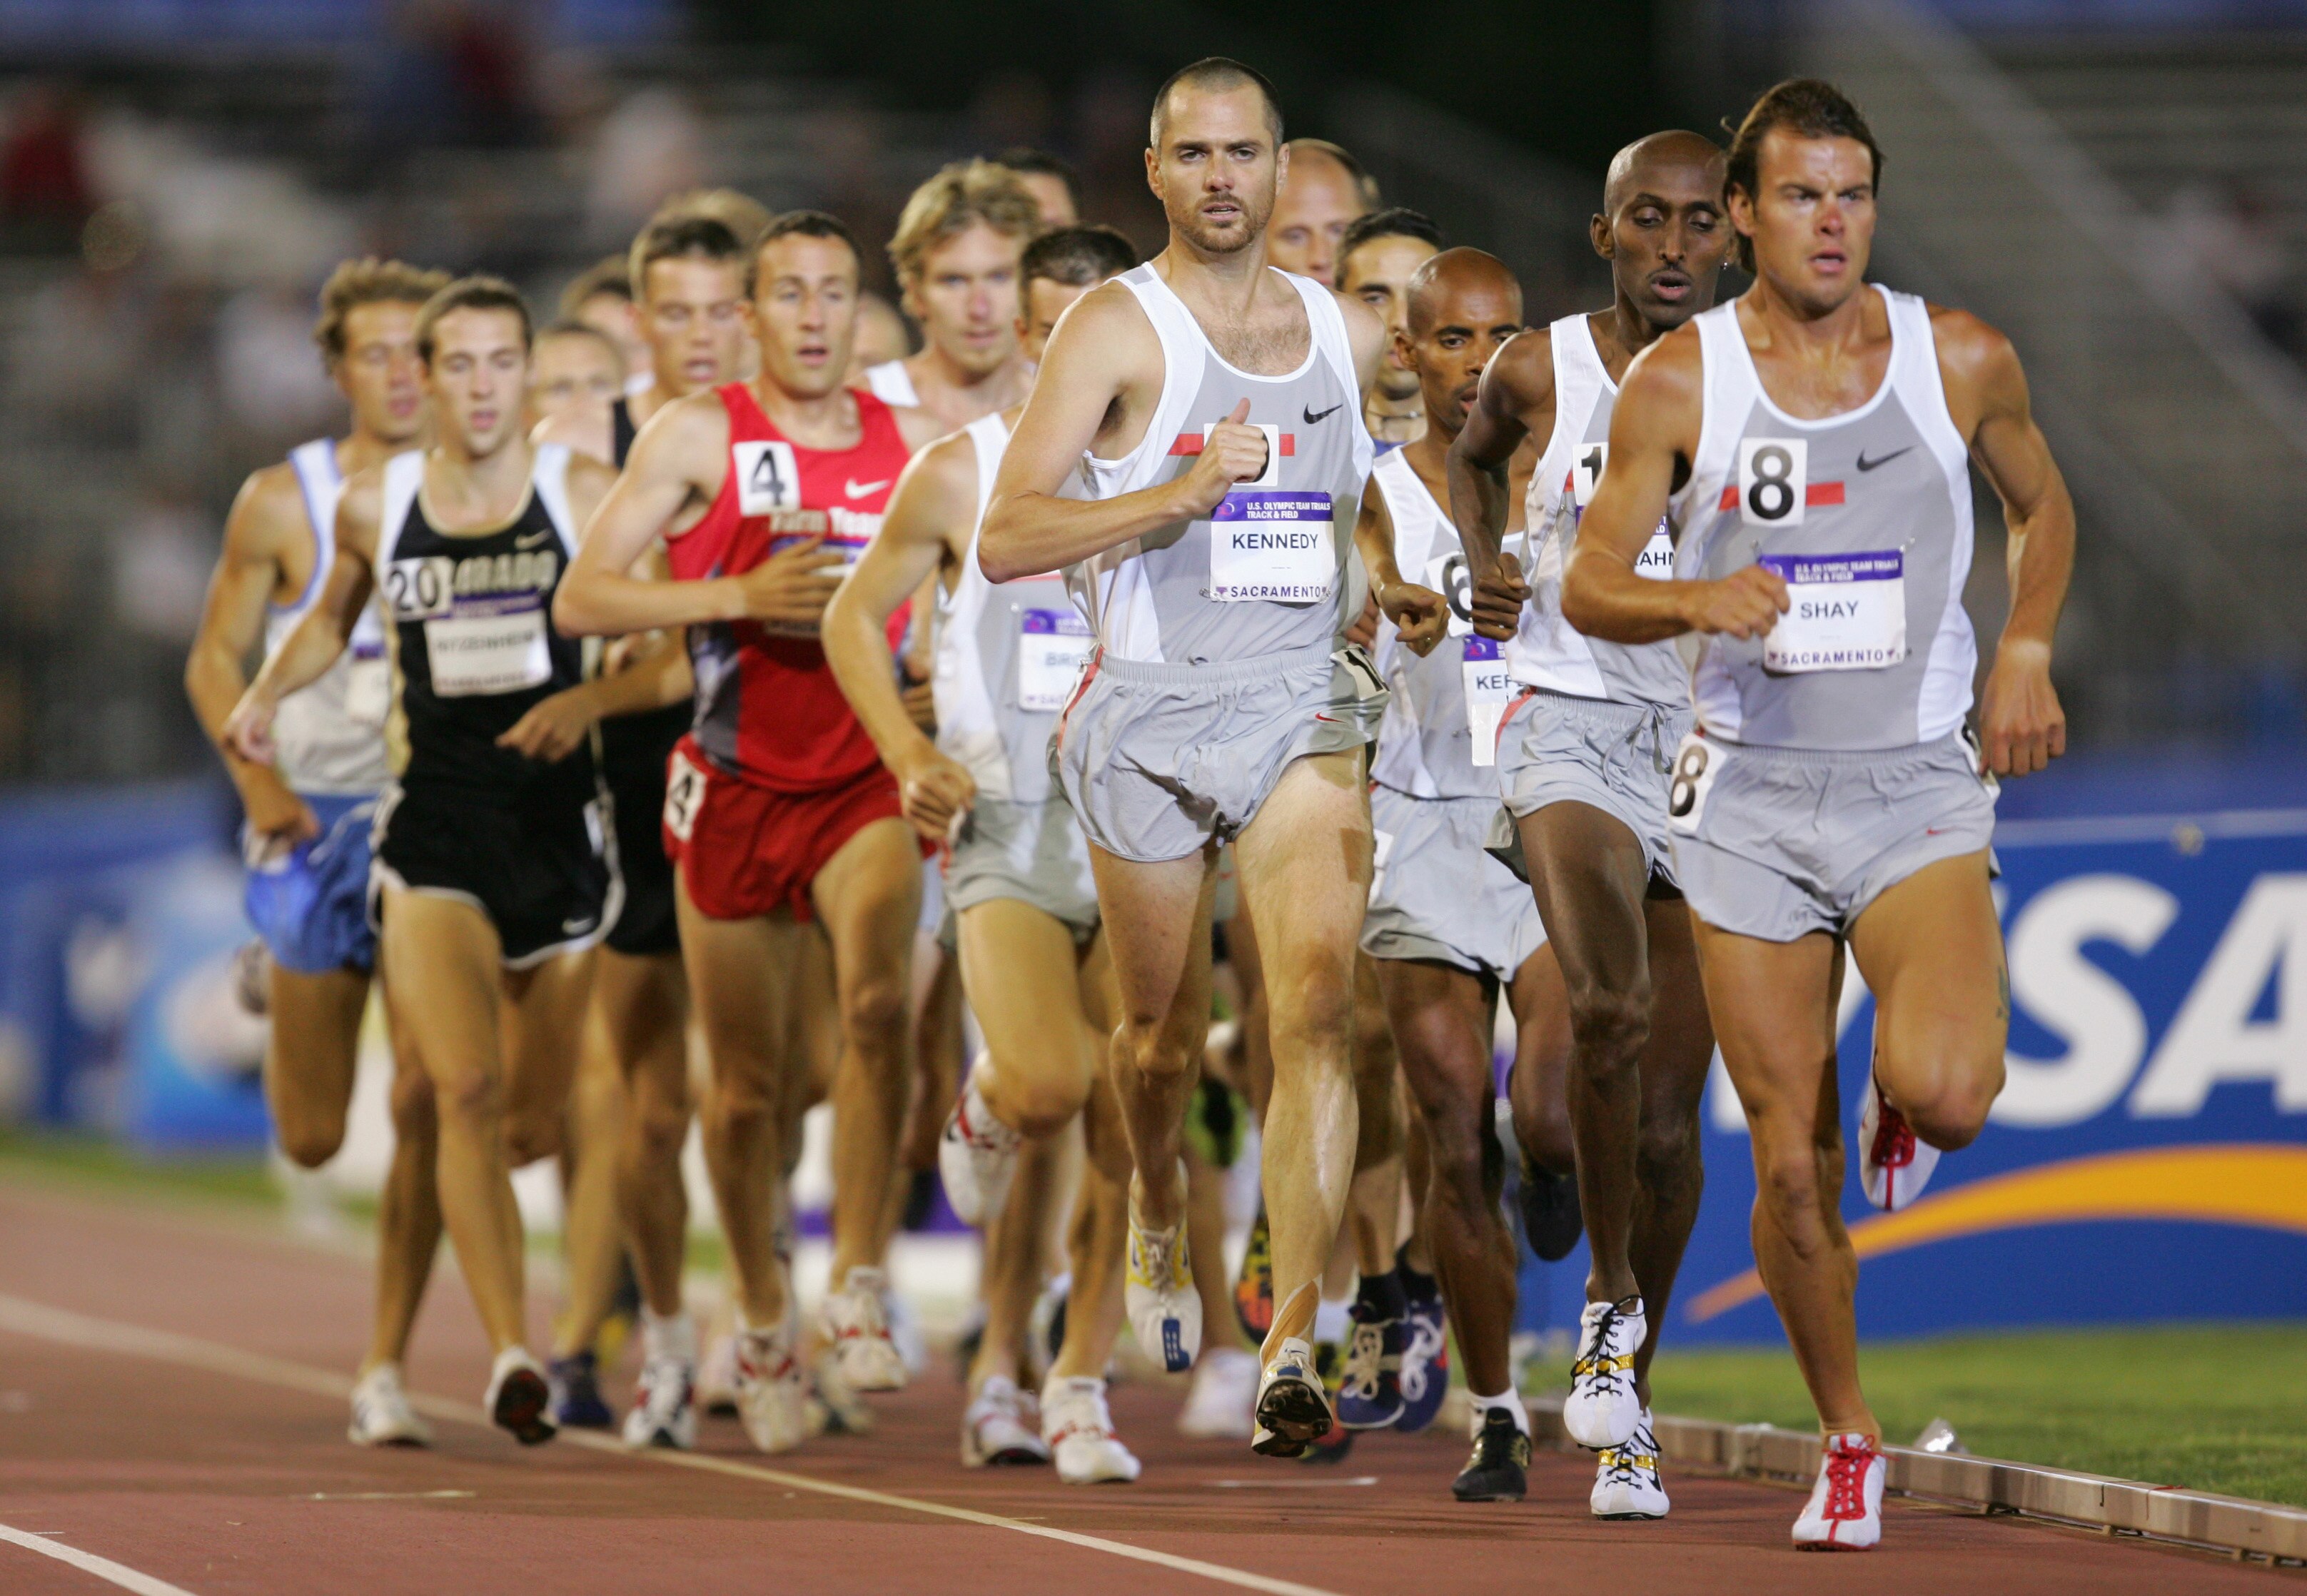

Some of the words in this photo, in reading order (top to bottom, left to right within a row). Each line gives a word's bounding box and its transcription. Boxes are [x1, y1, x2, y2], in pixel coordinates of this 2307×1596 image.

[749, 449, 785, 506] 4
[1749, 446, 1794, 520] 8
[1246, 502, 1262, 510] U.S.
[1263, 502, 1295, 510] OLYMPIC
[1296, 502, 1310, 510] TEAM
[1311, 502, 1331, 510] TRIALS
[1246, 510, 1272, 519] TRACK
[1232, 533, 1318, 549] KENNEDY
[387, 563, 440, 612] 20
[1231, 586, 1321, 597] SACRAMENTO
[1800, 601, 1859, 619] SHAY
[1780, 650, 1884, 665] SACRAMENTO
[1476, 674, 1526, 690] KEF
[1670, 743, 1708, 817] 8
